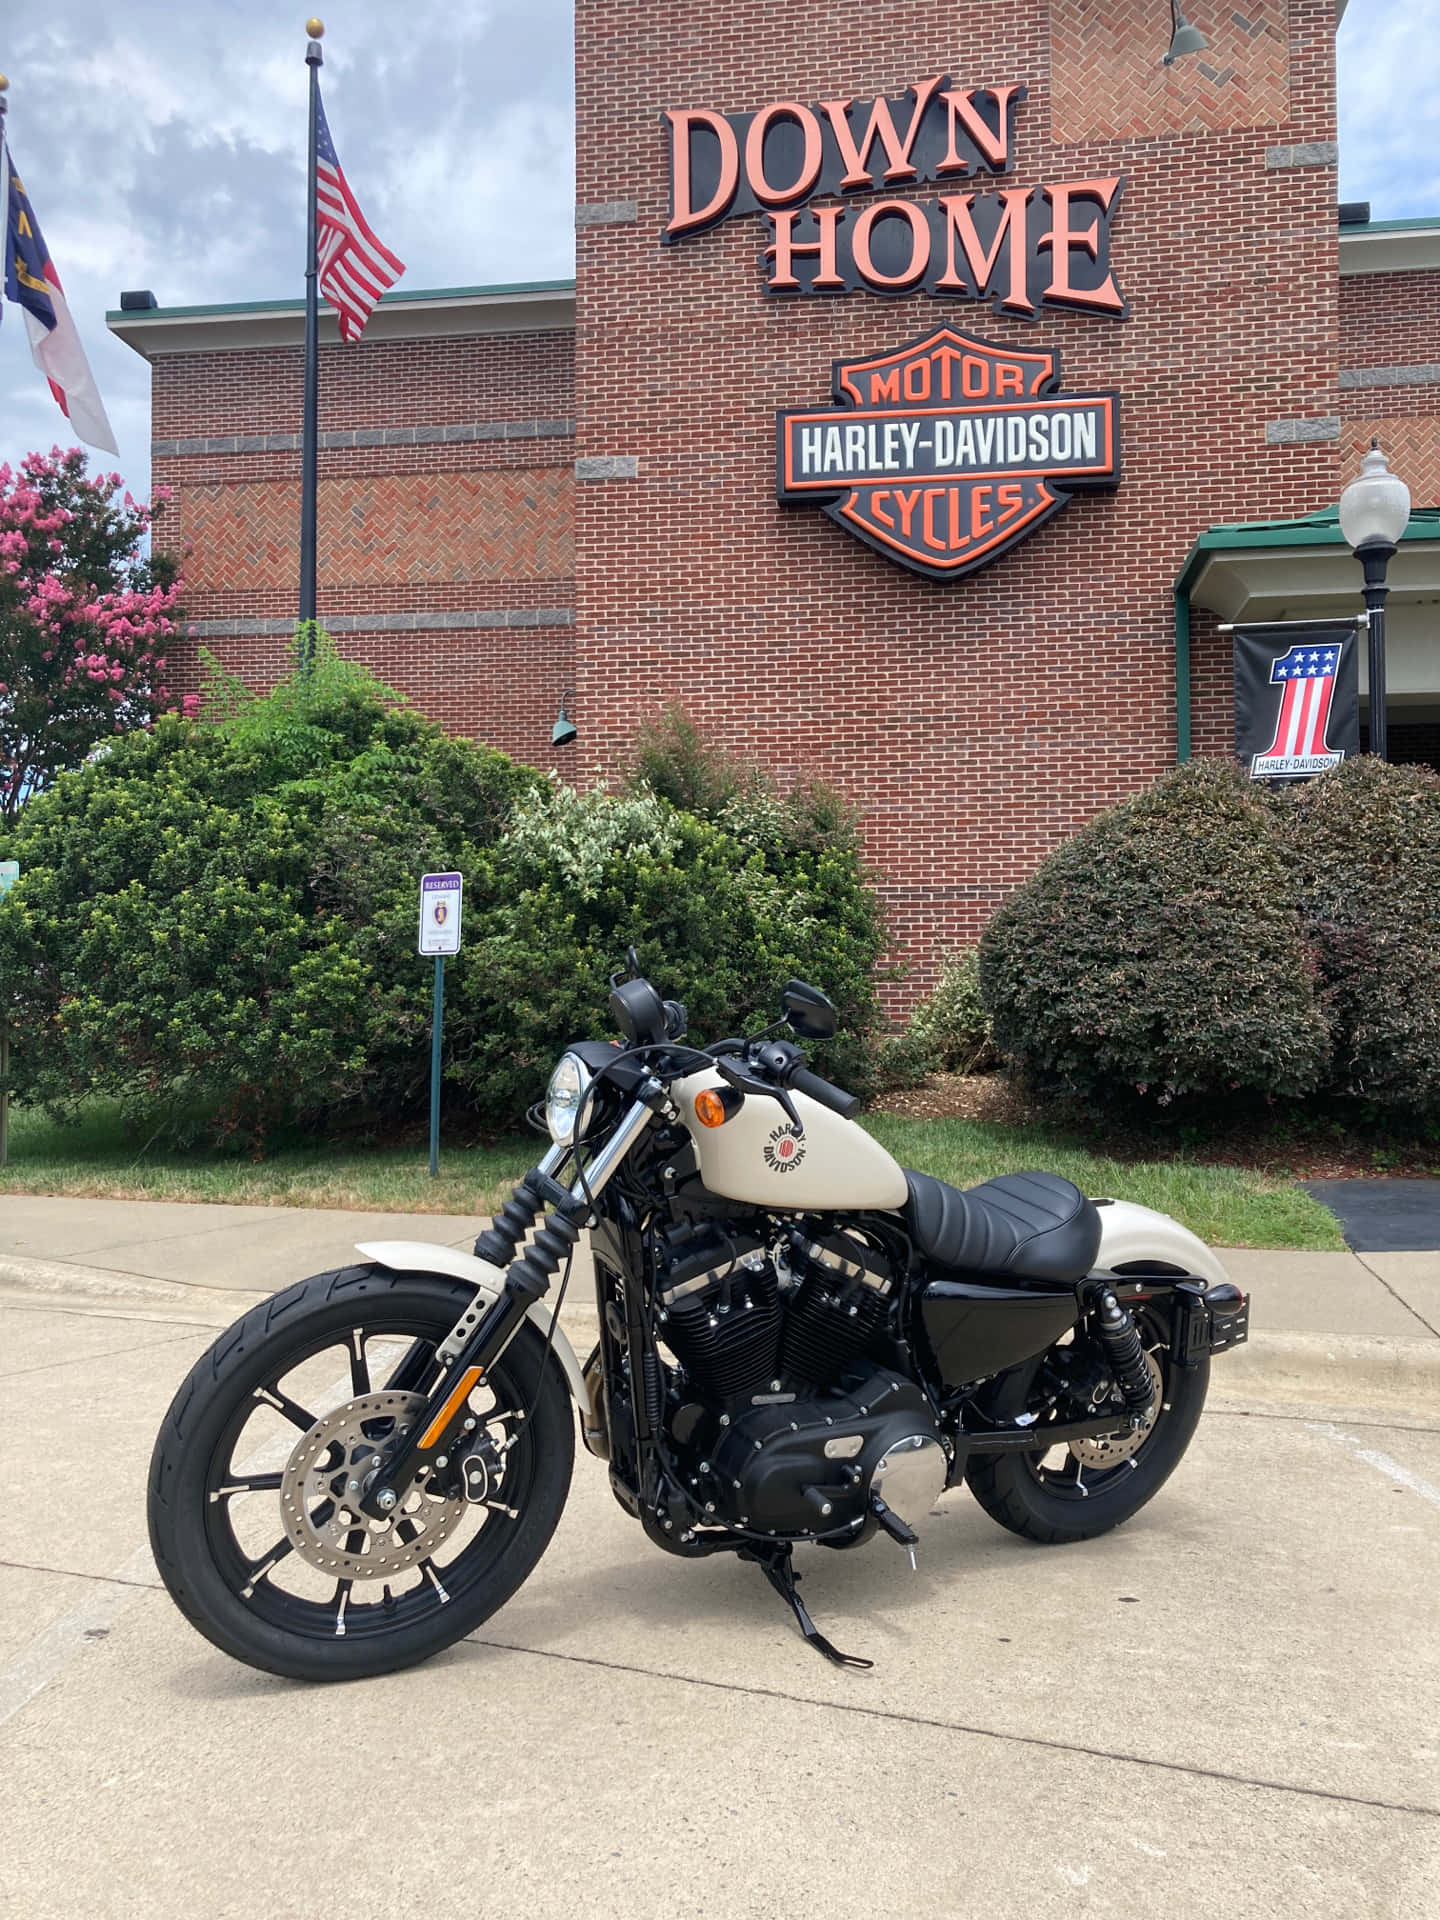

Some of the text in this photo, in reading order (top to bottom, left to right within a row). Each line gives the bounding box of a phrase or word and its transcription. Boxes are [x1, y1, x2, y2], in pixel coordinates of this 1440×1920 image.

[666, 75, 1025, 234] DOWN
[764, 177, 1125, 312] HOME
[871, 345, 1025, 404] MOTOR
[801, 411, 1098, 475] HARLEY-DAVIDSON
[870, 484, 1024, 552] CYCLES
[763, 1146, 806, 1173] DAVIDSON
[769, 1123, 806, 1142] HARY
